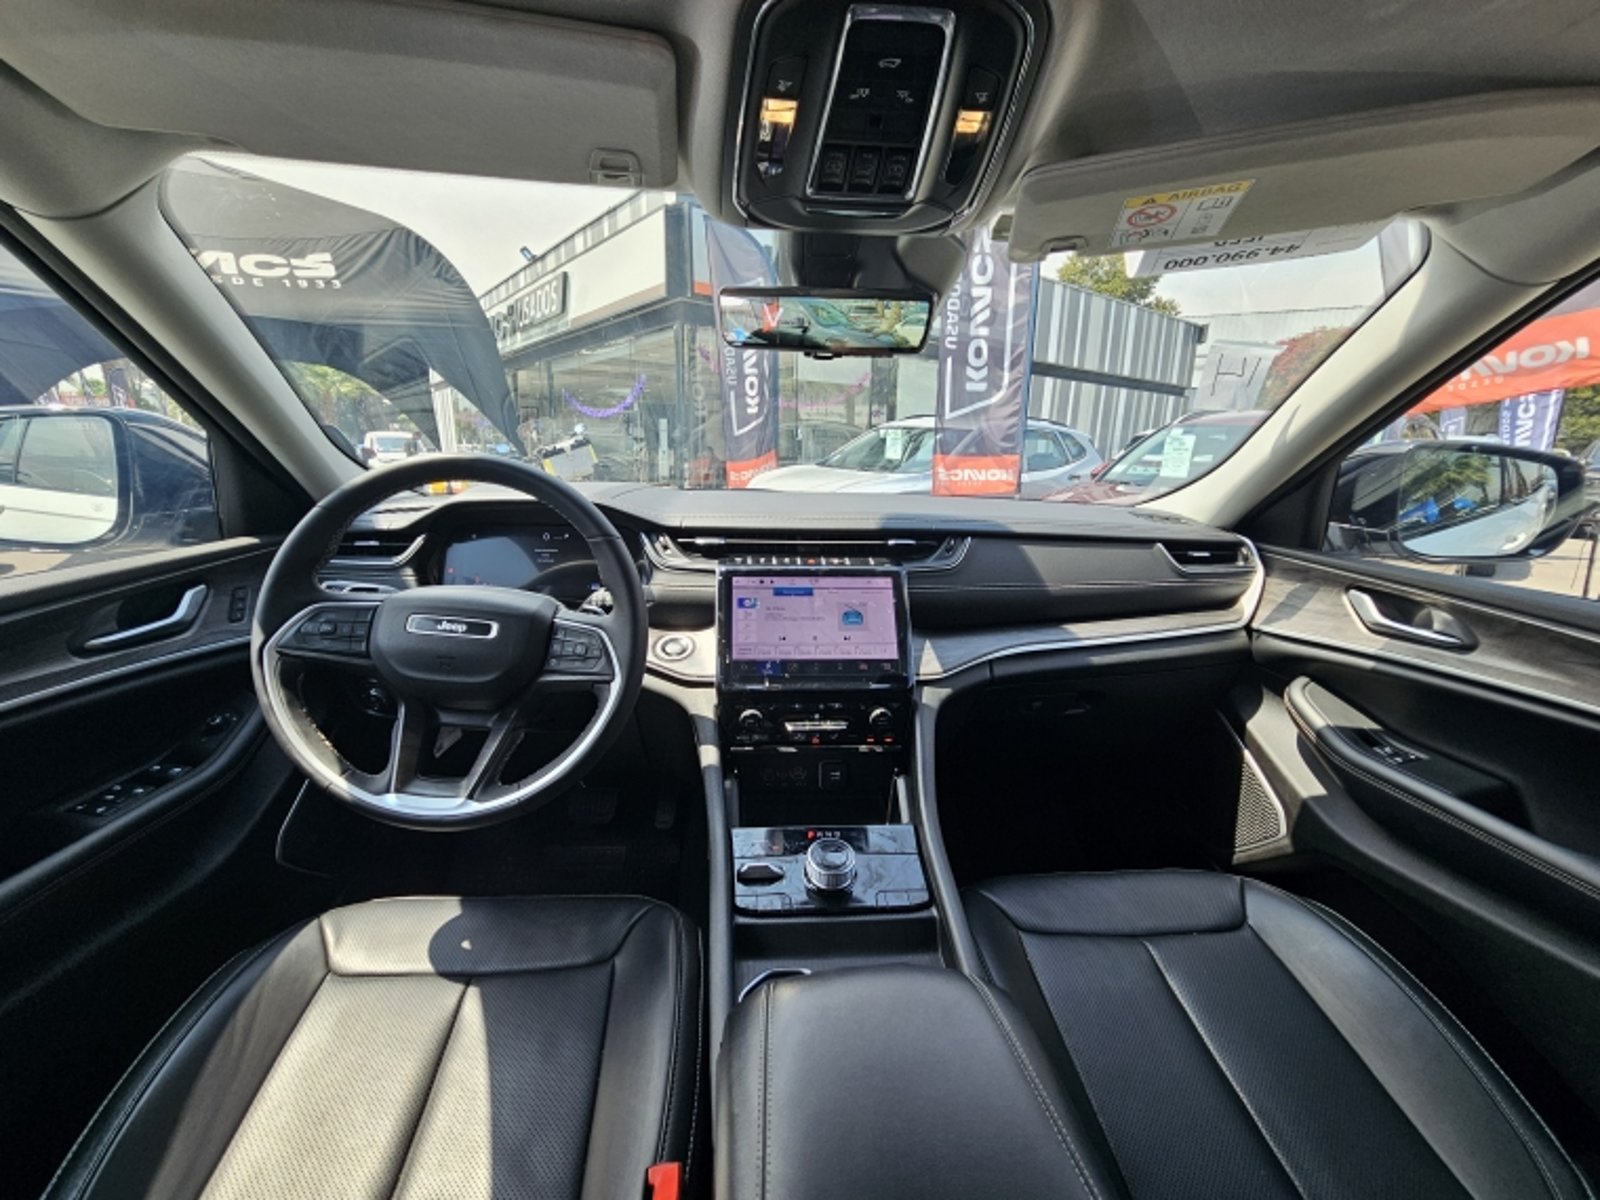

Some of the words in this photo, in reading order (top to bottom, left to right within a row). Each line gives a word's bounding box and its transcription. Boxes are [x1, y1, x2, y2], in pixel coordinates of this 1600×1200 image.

[1167, 182, 1243, 201] AIRBAG
[188, 248, 336, 278] ACS
[1163, 243, 1301, 271] 44.990.000
[436, 620, 467, 633] Jeep
